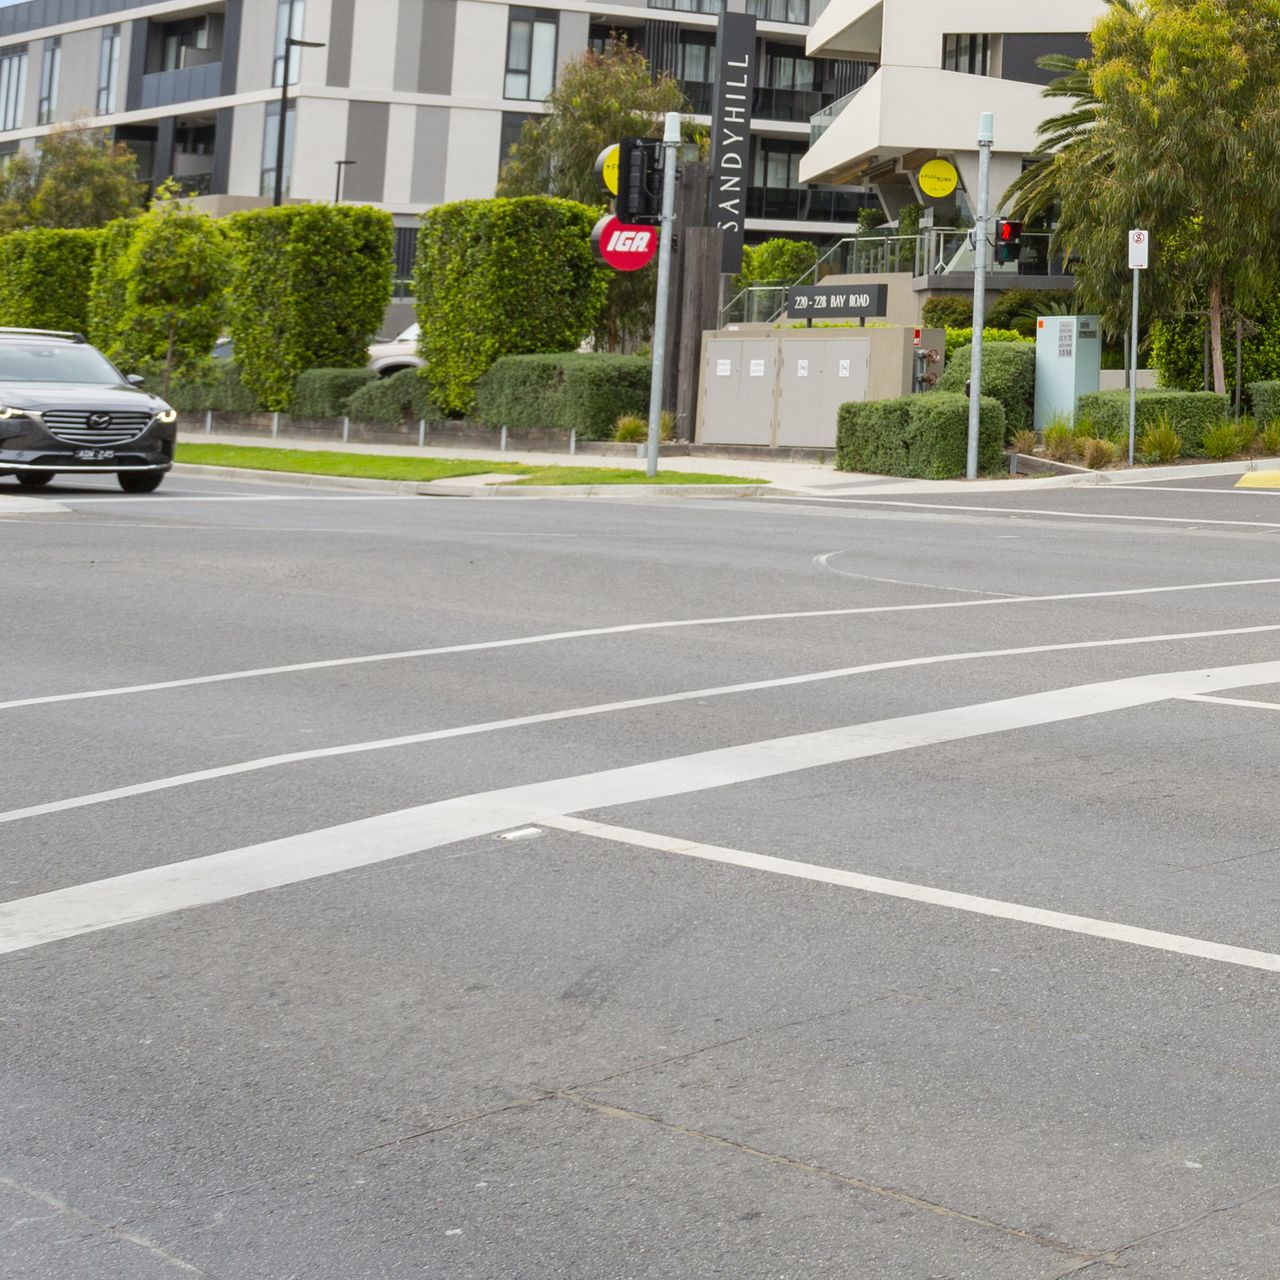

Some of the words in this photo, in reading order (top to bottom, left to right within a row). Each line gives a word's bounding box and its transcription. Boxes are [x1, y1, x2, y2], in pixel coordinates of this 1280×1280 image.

[717, 54, 749, 232] SANDYHILL
[606, 230, 652, 253] IGA
[830, 294, 846, 308] BAY
[849, 293, 870, 307] ROAD
